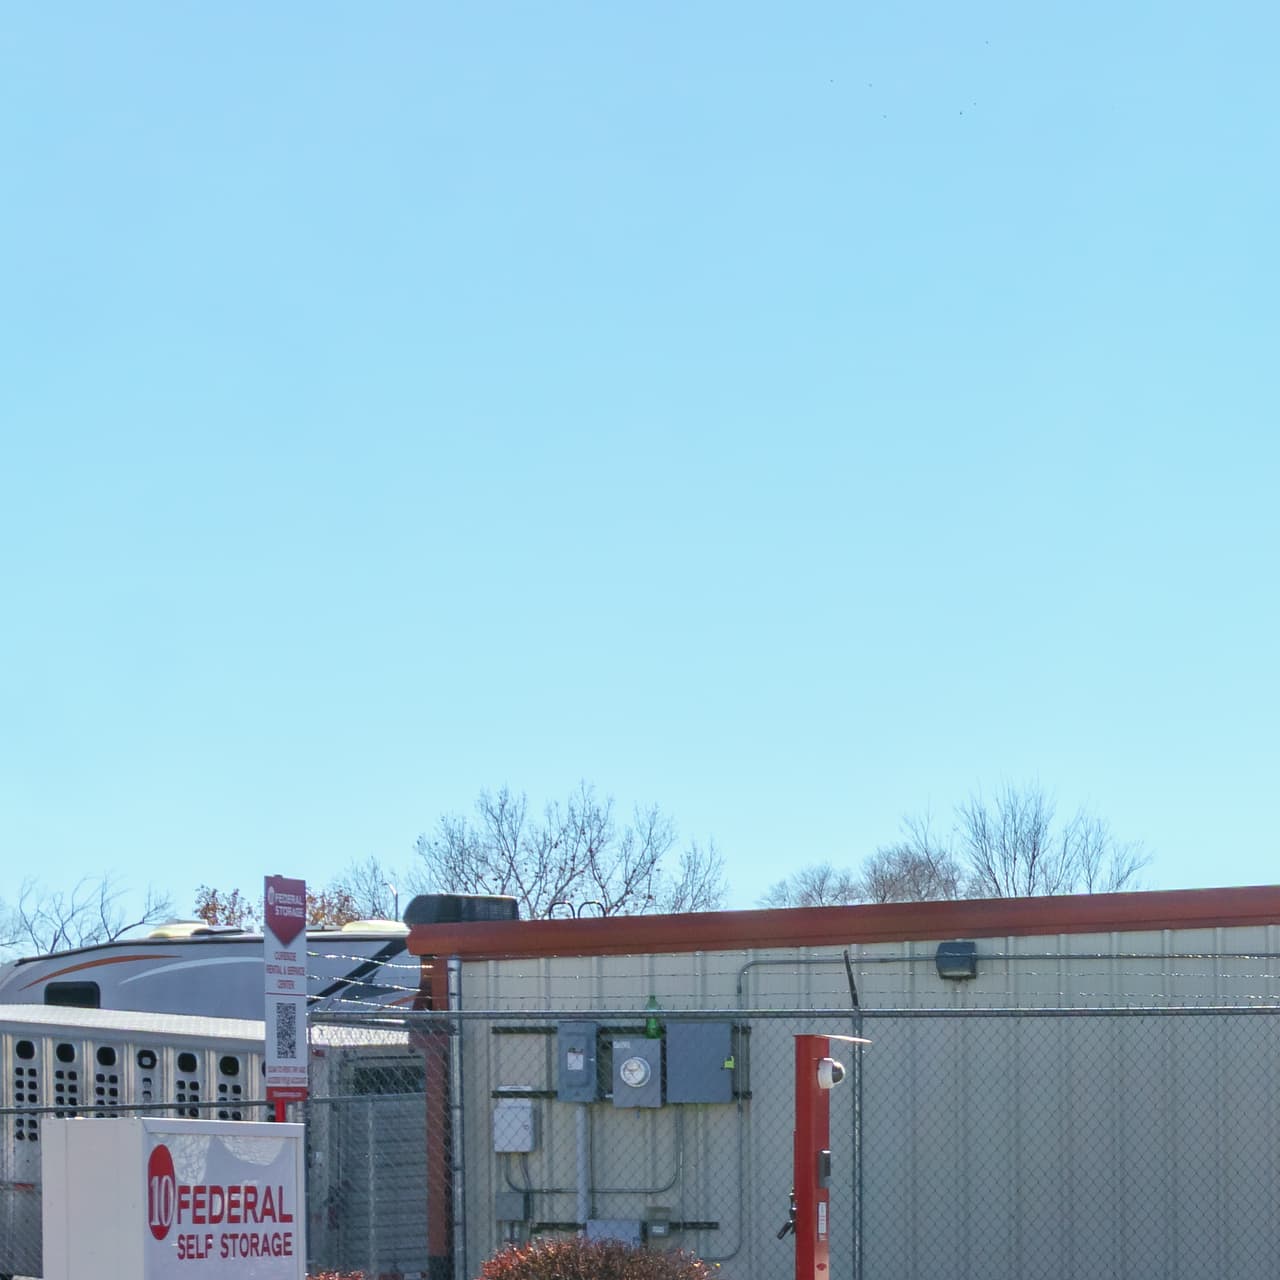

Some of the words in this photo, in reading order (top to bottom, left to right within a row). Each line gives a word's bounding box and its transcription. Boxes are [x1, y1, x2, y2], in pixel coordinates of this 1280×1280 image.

[150, 1174, 176, 1227] 10
[176, 1185, 294, 1225] FEDERAL
[177, 1233, 214, 1260] SELF
[219, 1231, 294, 1259] STORAGE
